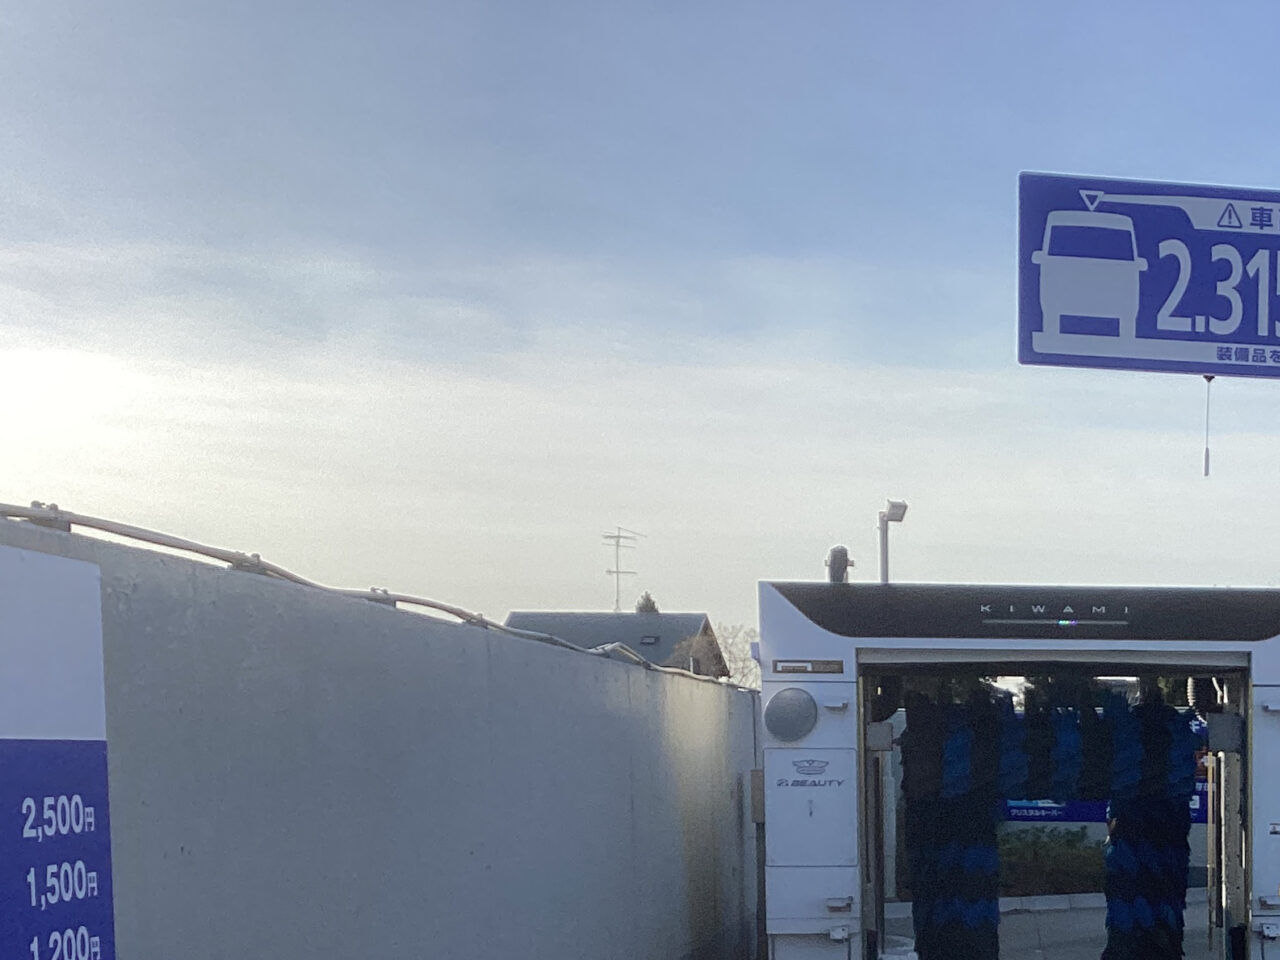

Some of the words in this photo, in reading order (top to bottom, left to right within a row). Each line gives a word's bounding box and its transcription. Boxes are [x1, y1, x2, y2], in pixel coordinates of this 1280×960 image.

[980, 604, 1129, 614] KIWAMI
[22, 794, 95, 843] 2,500円
[27, 860, 98, 911] 1,500円
